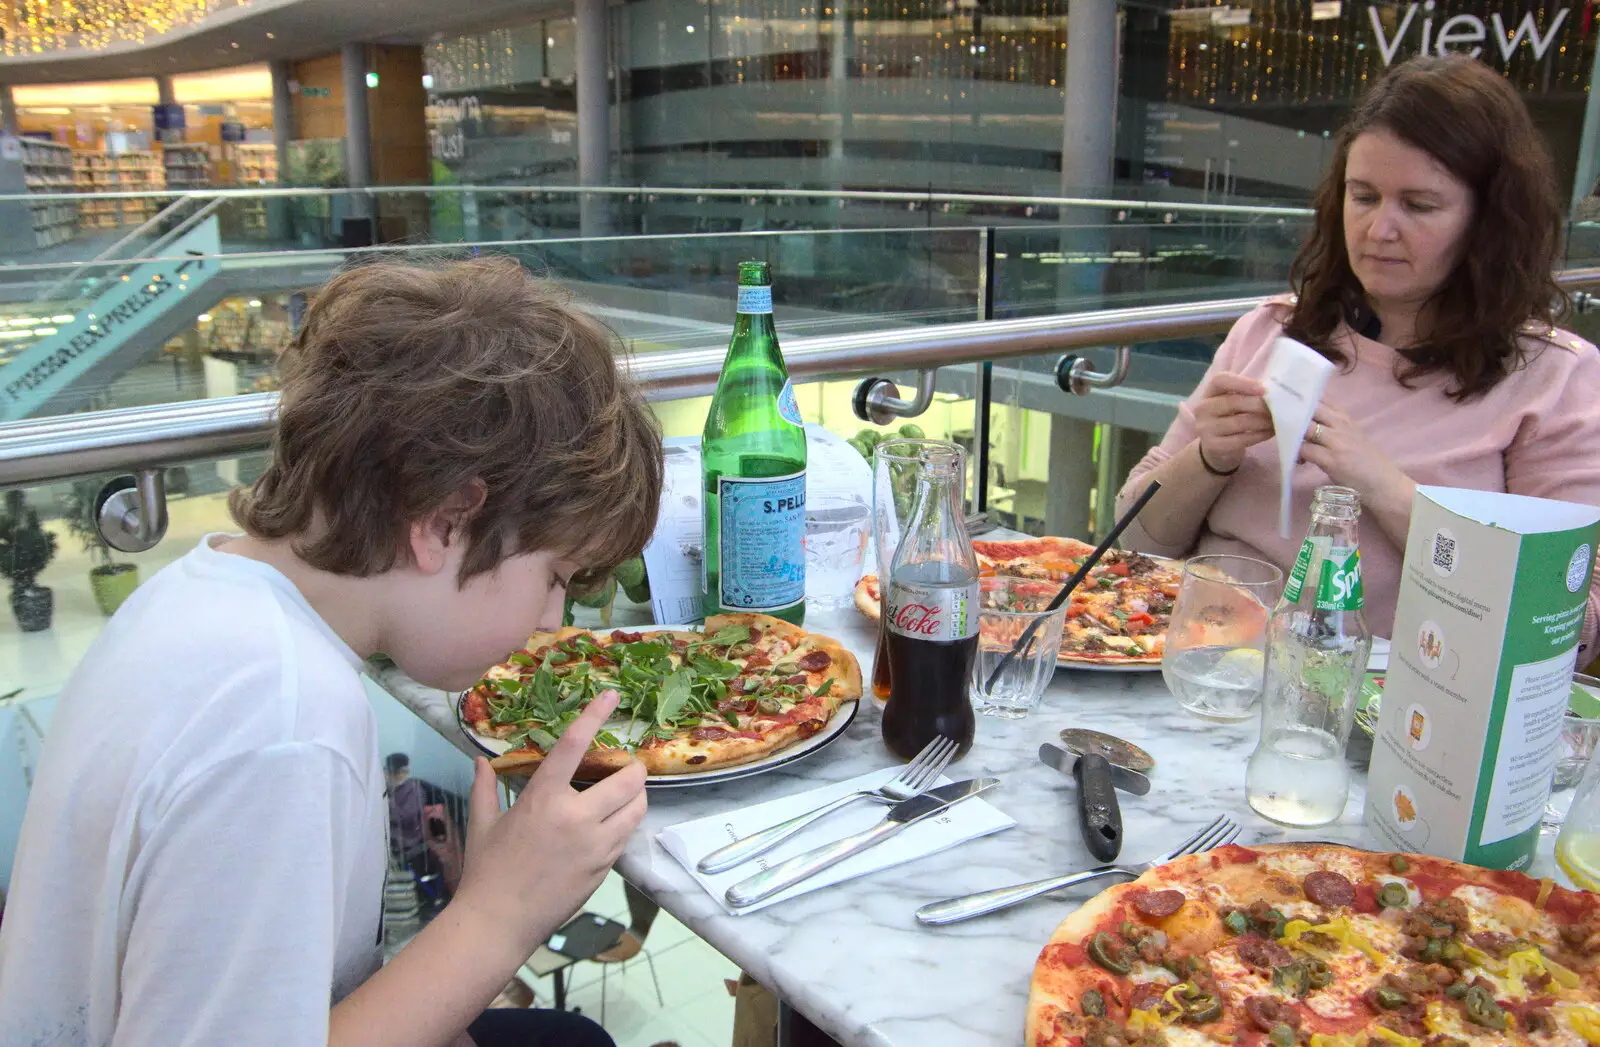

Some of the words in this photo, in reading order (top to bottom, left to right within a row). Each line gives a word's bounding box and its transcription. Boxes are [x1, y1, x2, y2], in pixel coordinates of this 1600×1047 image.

[1368, 0, 1570, 67] View
[1456, 592, 1474, 606] digital
[1473, 601, 1491, 613] menu
[896, 603, 943, 635] Coke
[1532, 613, 1559, 625] Serving
